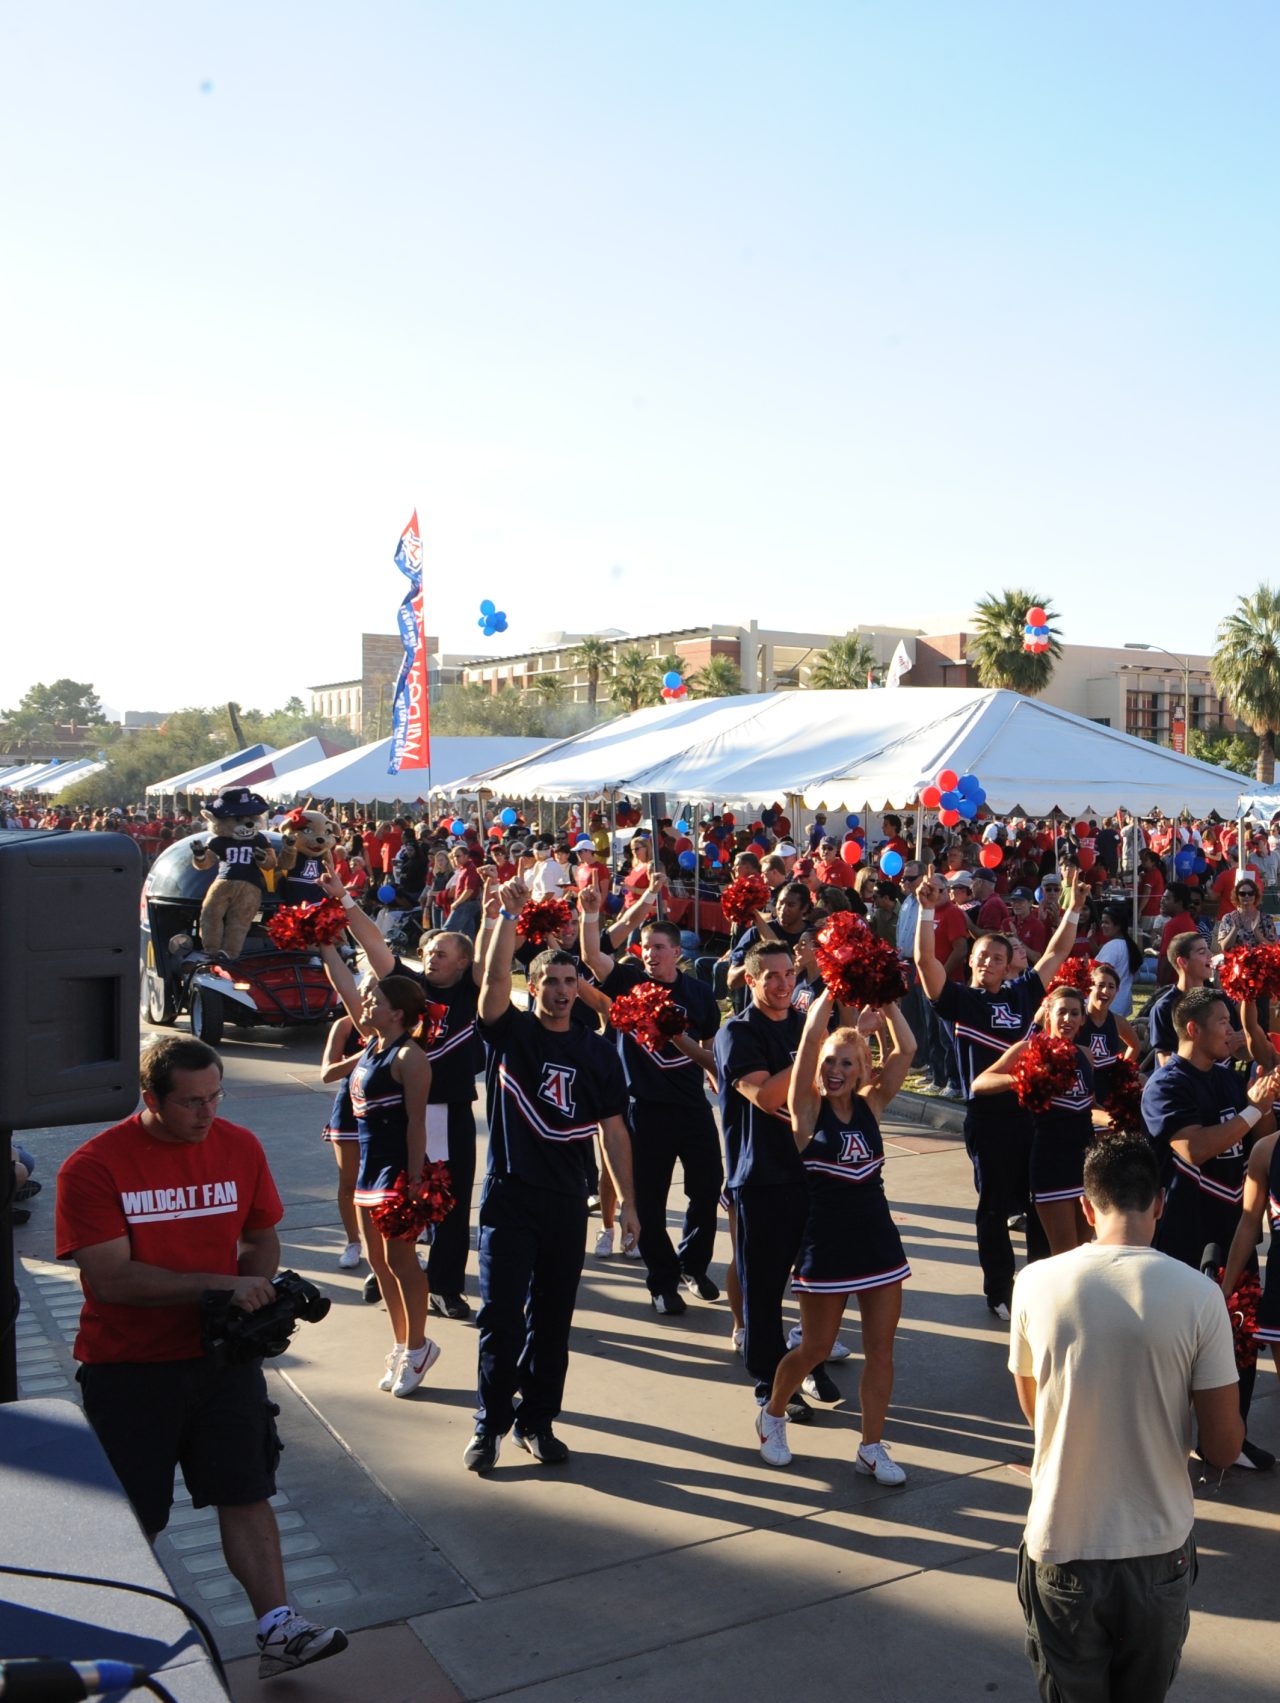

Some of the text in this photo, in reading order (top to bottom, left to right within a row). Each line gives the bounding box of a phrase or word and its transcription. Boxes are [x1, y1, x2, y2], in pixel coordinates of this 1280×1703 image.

[226, 846, 253, 864] 00
[303, 861, 319, 877] A
[793, 990, 812, 1013] A
[1090, 1034, 1110, 1057] A
[537, 1062, 576, 1118] A
[837, 1131, 873, 1164] A
[121, 1181, 238, 1214] WILDCAT FAN
